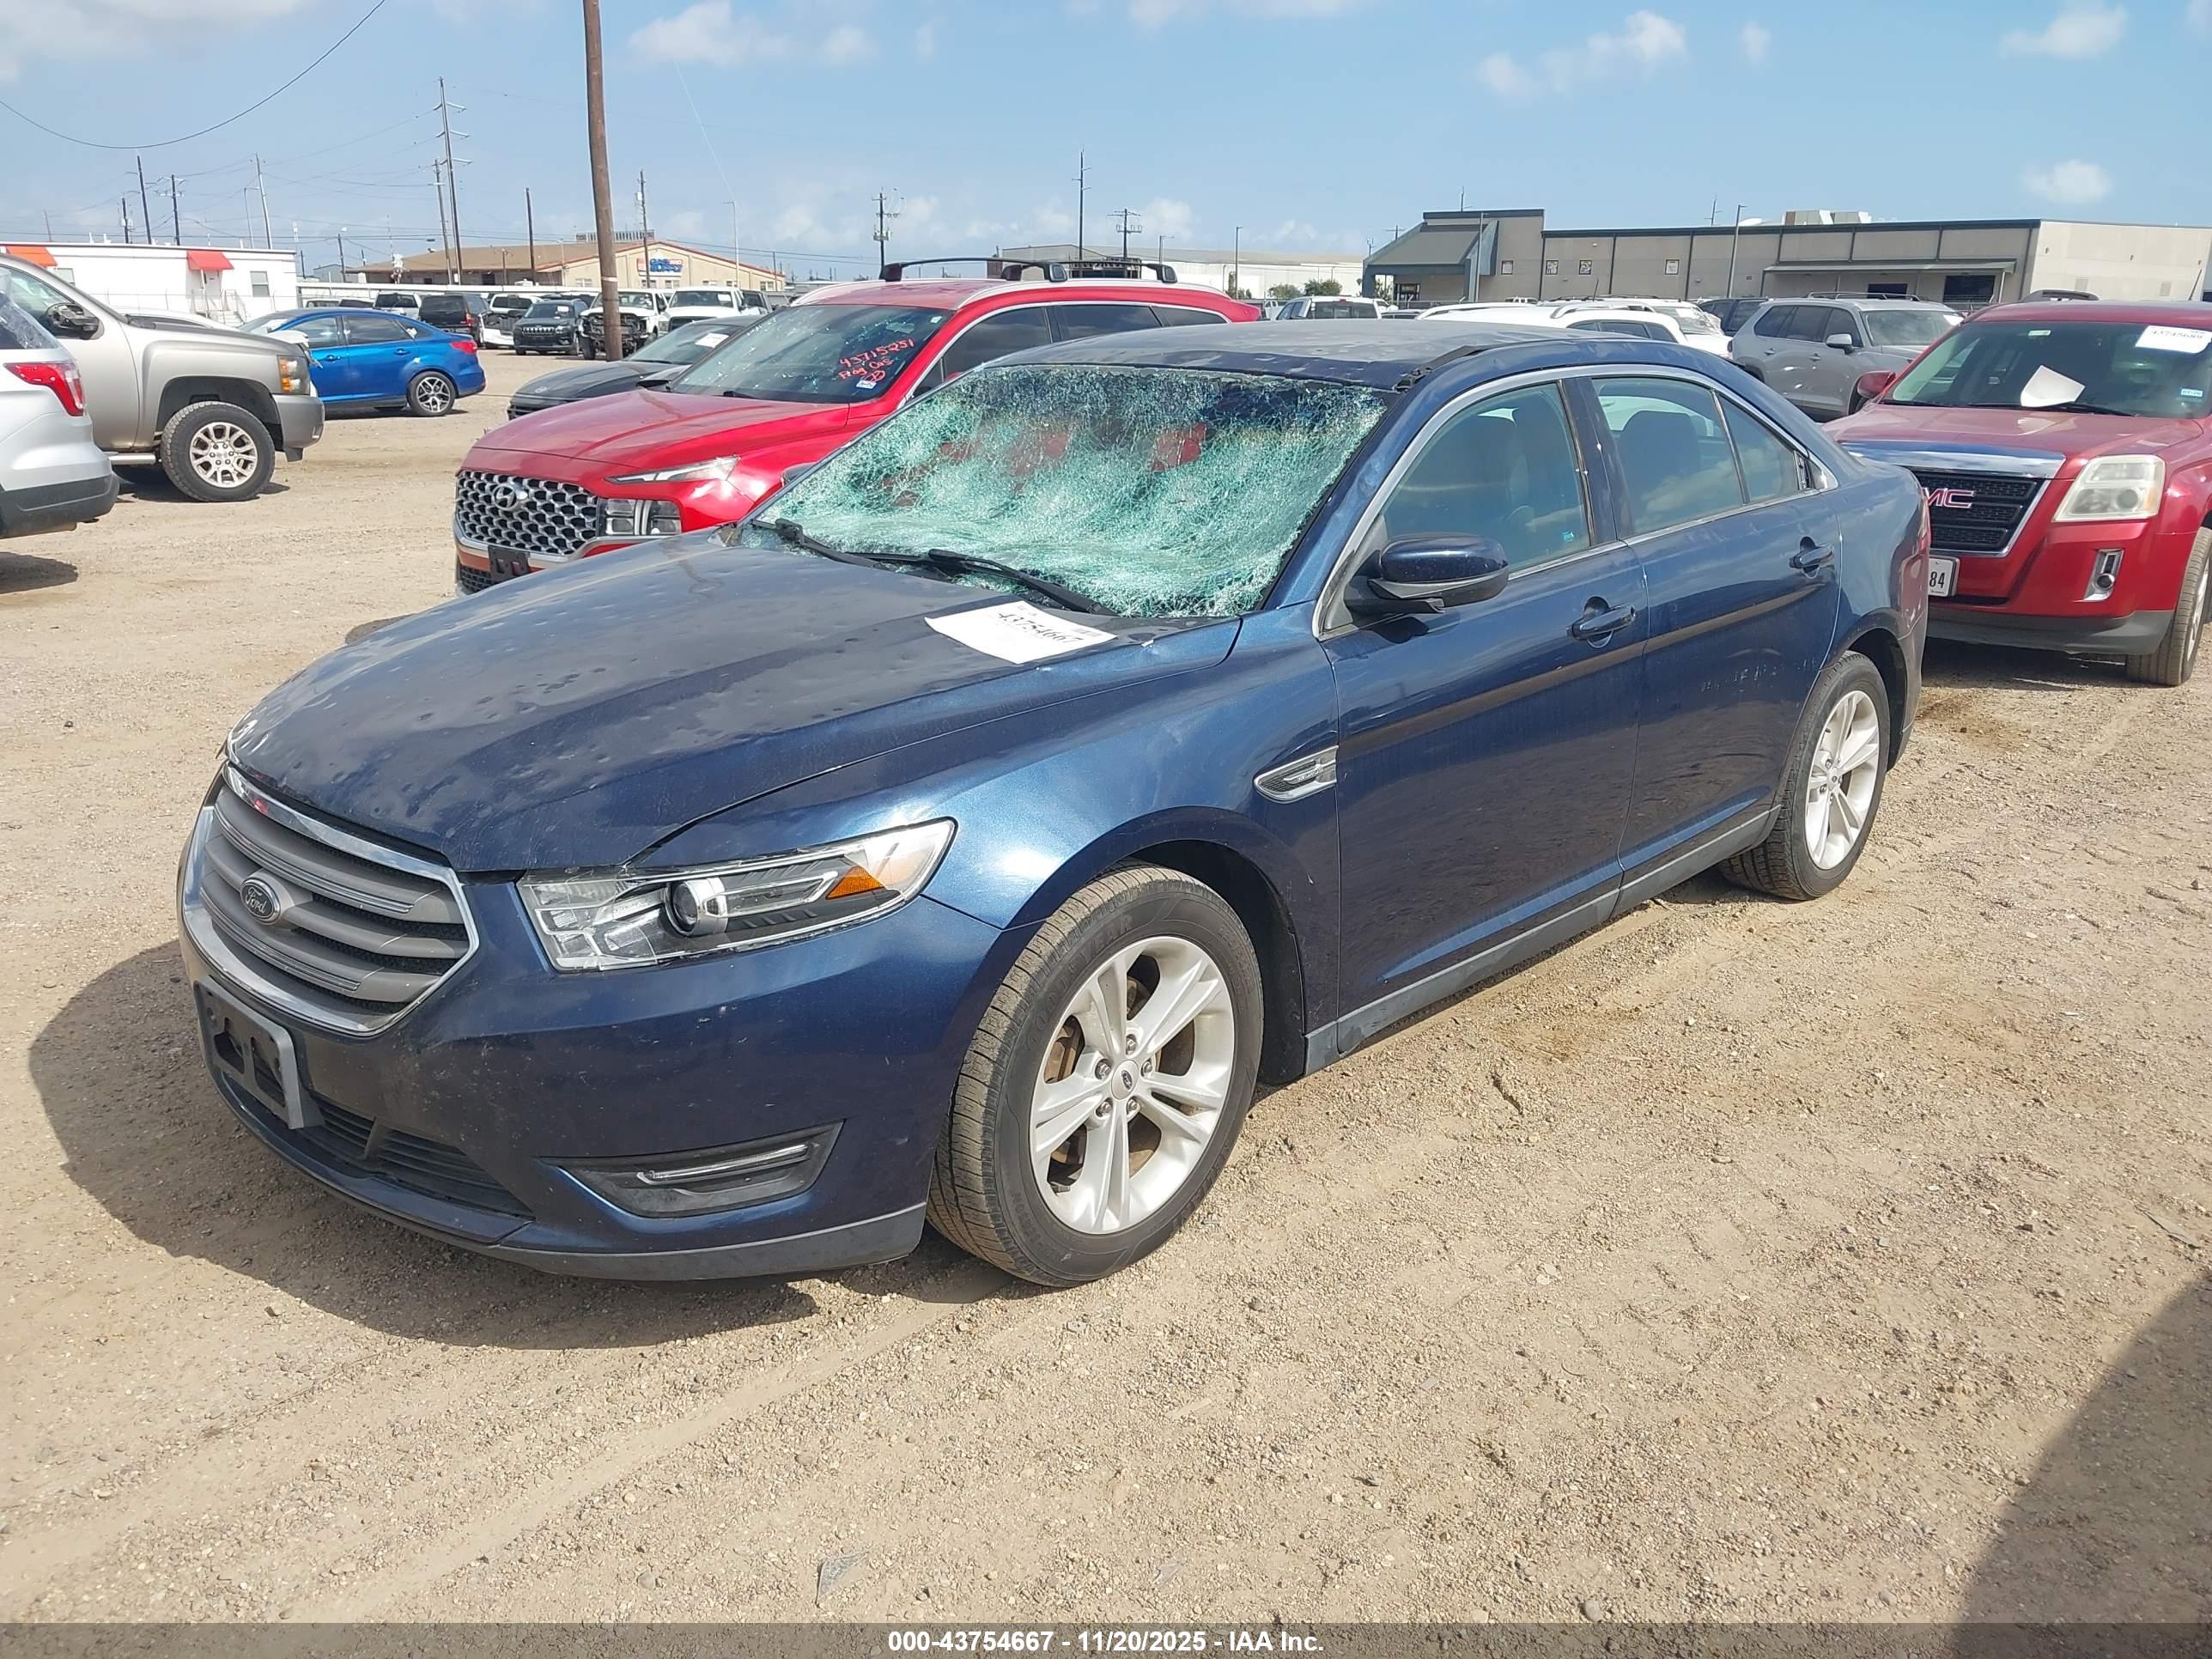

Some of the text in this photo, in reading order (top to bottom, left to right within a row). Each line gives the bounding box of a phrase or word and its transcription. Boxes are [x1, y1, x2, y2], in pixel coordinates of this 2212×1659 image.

[1921, 487, 1975, 509] MC
[1929, 571, 1945, 588] 84
[245, 886, 268, 914] Ford
